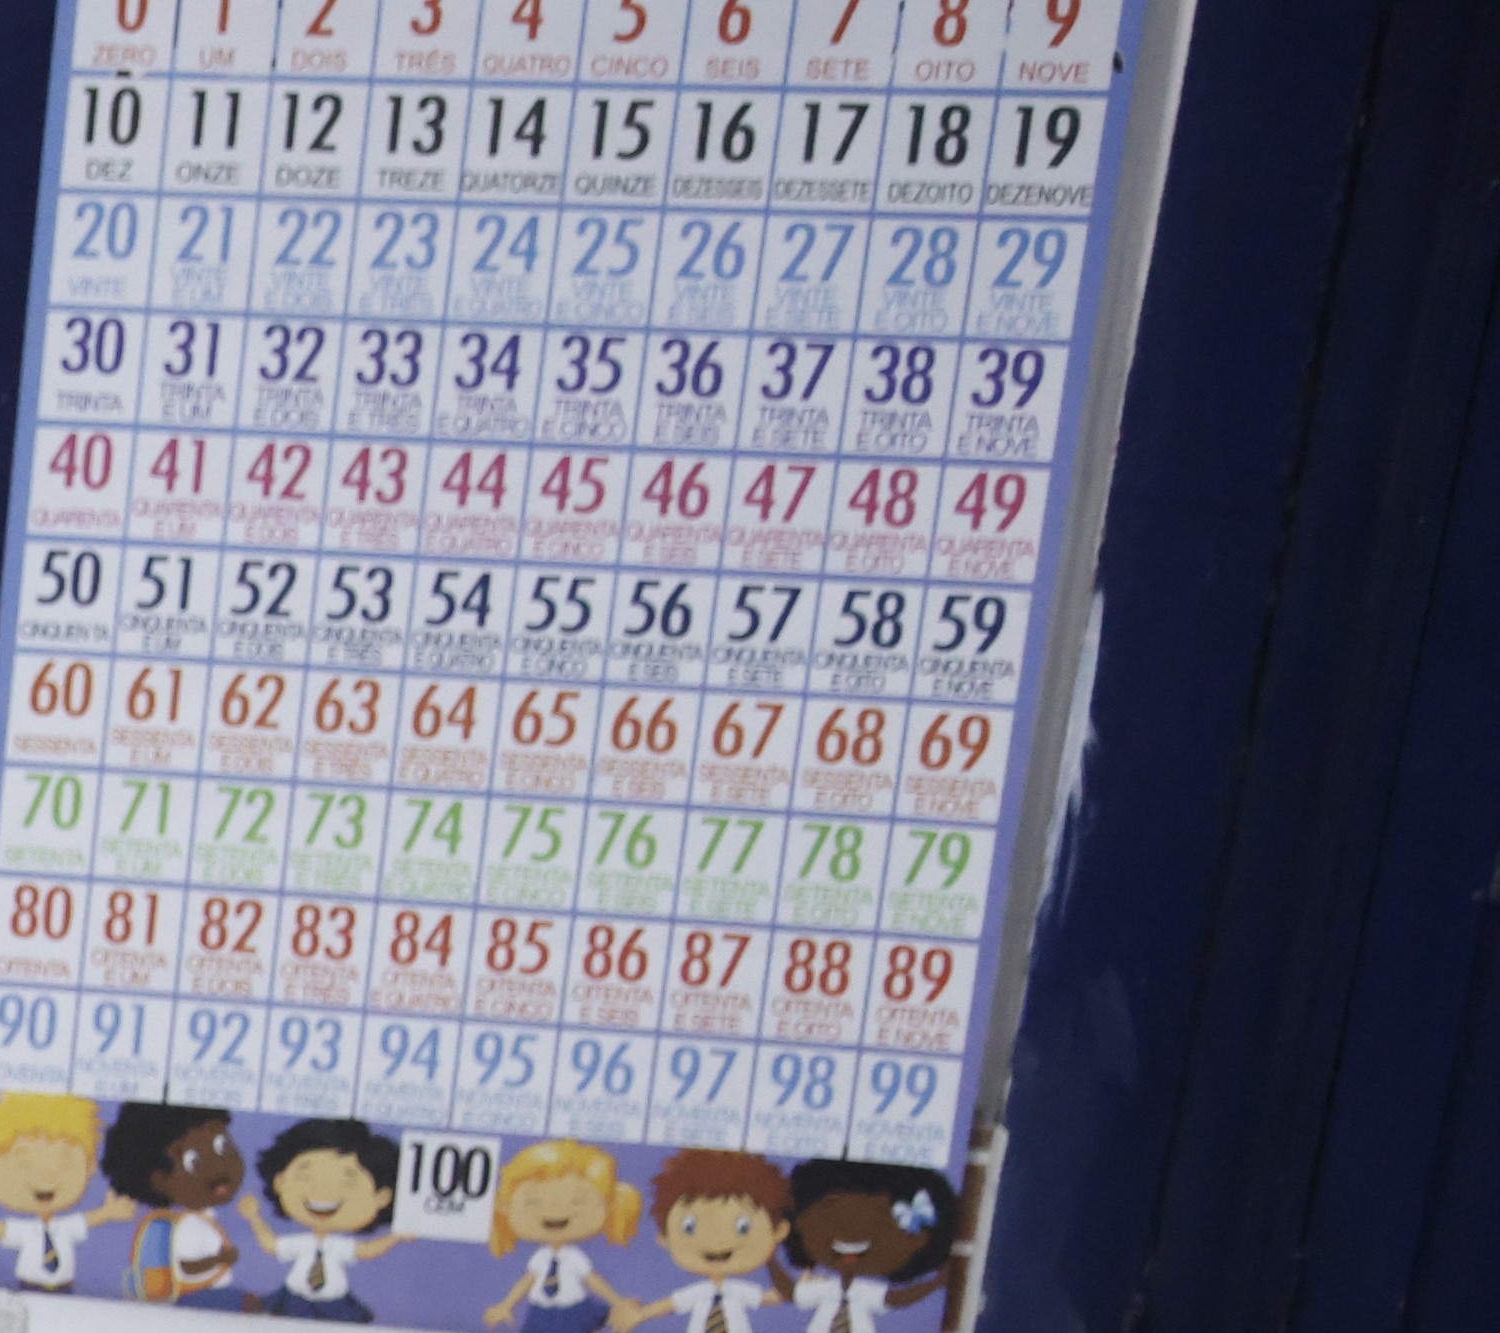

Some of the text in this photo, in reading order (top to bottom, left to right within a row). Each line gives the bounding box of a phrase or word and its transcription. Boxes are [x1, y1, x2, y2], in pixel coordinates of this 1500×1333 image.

[410, 0, 442, 35] 3
[511, 0, 542, 40] 4
[613, 0, 646, 42] 5
[718, 0, 751, 43] 6
[830, 0, 858, 44] 7
[933, 0, 968, 46] 8
[1046, 0, 1080, 46] 9
[91, 45, 155, 68] ZERO
[199, 48, 234, 69] UM
[291, 51, 348, 72] DOIS
[395, 48, 456, 74] TRÊS
[483, 55, 570, 79] QUATRO
[591, 58, 668, 80] CINCO
[706, 59, 759, 81] SEIS
[807, 60, 870, 82] SETE
[916, 61, 975, 83] OITO
[1020, 63, 1088, 85] NOVE
[85, 87, 1080, 167] 10 11 12 13 14 15 16 17 18 19
[86, 160, 133, 182] DEZ
[177, 164, 238, 185] ONZE
[277, 166, 339, 188] DOZE
[380, 168, 443, 191] TREZE
[575, 174, 654, 198] QUINZE
[888, 181, 973, 205] DEZOITO
[987, 182, 1092, 207] DEZENOVE
[73, 199, 1067, 289] 20 21 22 23 24 25 26 27 28 29
[61, 315, 1044, 408] 30 31 32 33 34 35 36 37 38 39
[49, 432, 1026, 531] 40 41 42 43 44 45 46 47 48 49
[37, 550, 1006, 653] 50 51 52 53 54 55 56 57 58 59
[30, 661, 990, 770] 60 61 62 63 64 65 66 67 68 69
[24, 769, 971, 888] 70 71 72 73 74 75 76 77 78 79
[10, 884, 953, 1002] 80 81 82 83 84 85 86 87 88 89
[93, 1001, 145, 1057] 91
[188, 1008, 250, 1065] 92
[279, 1015, 342, 1073] 93
[380, 1023, 440, 1081] 94
[473, 1031, 536, 1088] 95
[571, 1038, 634, 1096] 96
[670, 1045, 738, 1102] 97
[770, 1052, 836, 1110] 98
[870, 1060, 937, 1118] 99
[409, 1136, 491, 1196] 100
